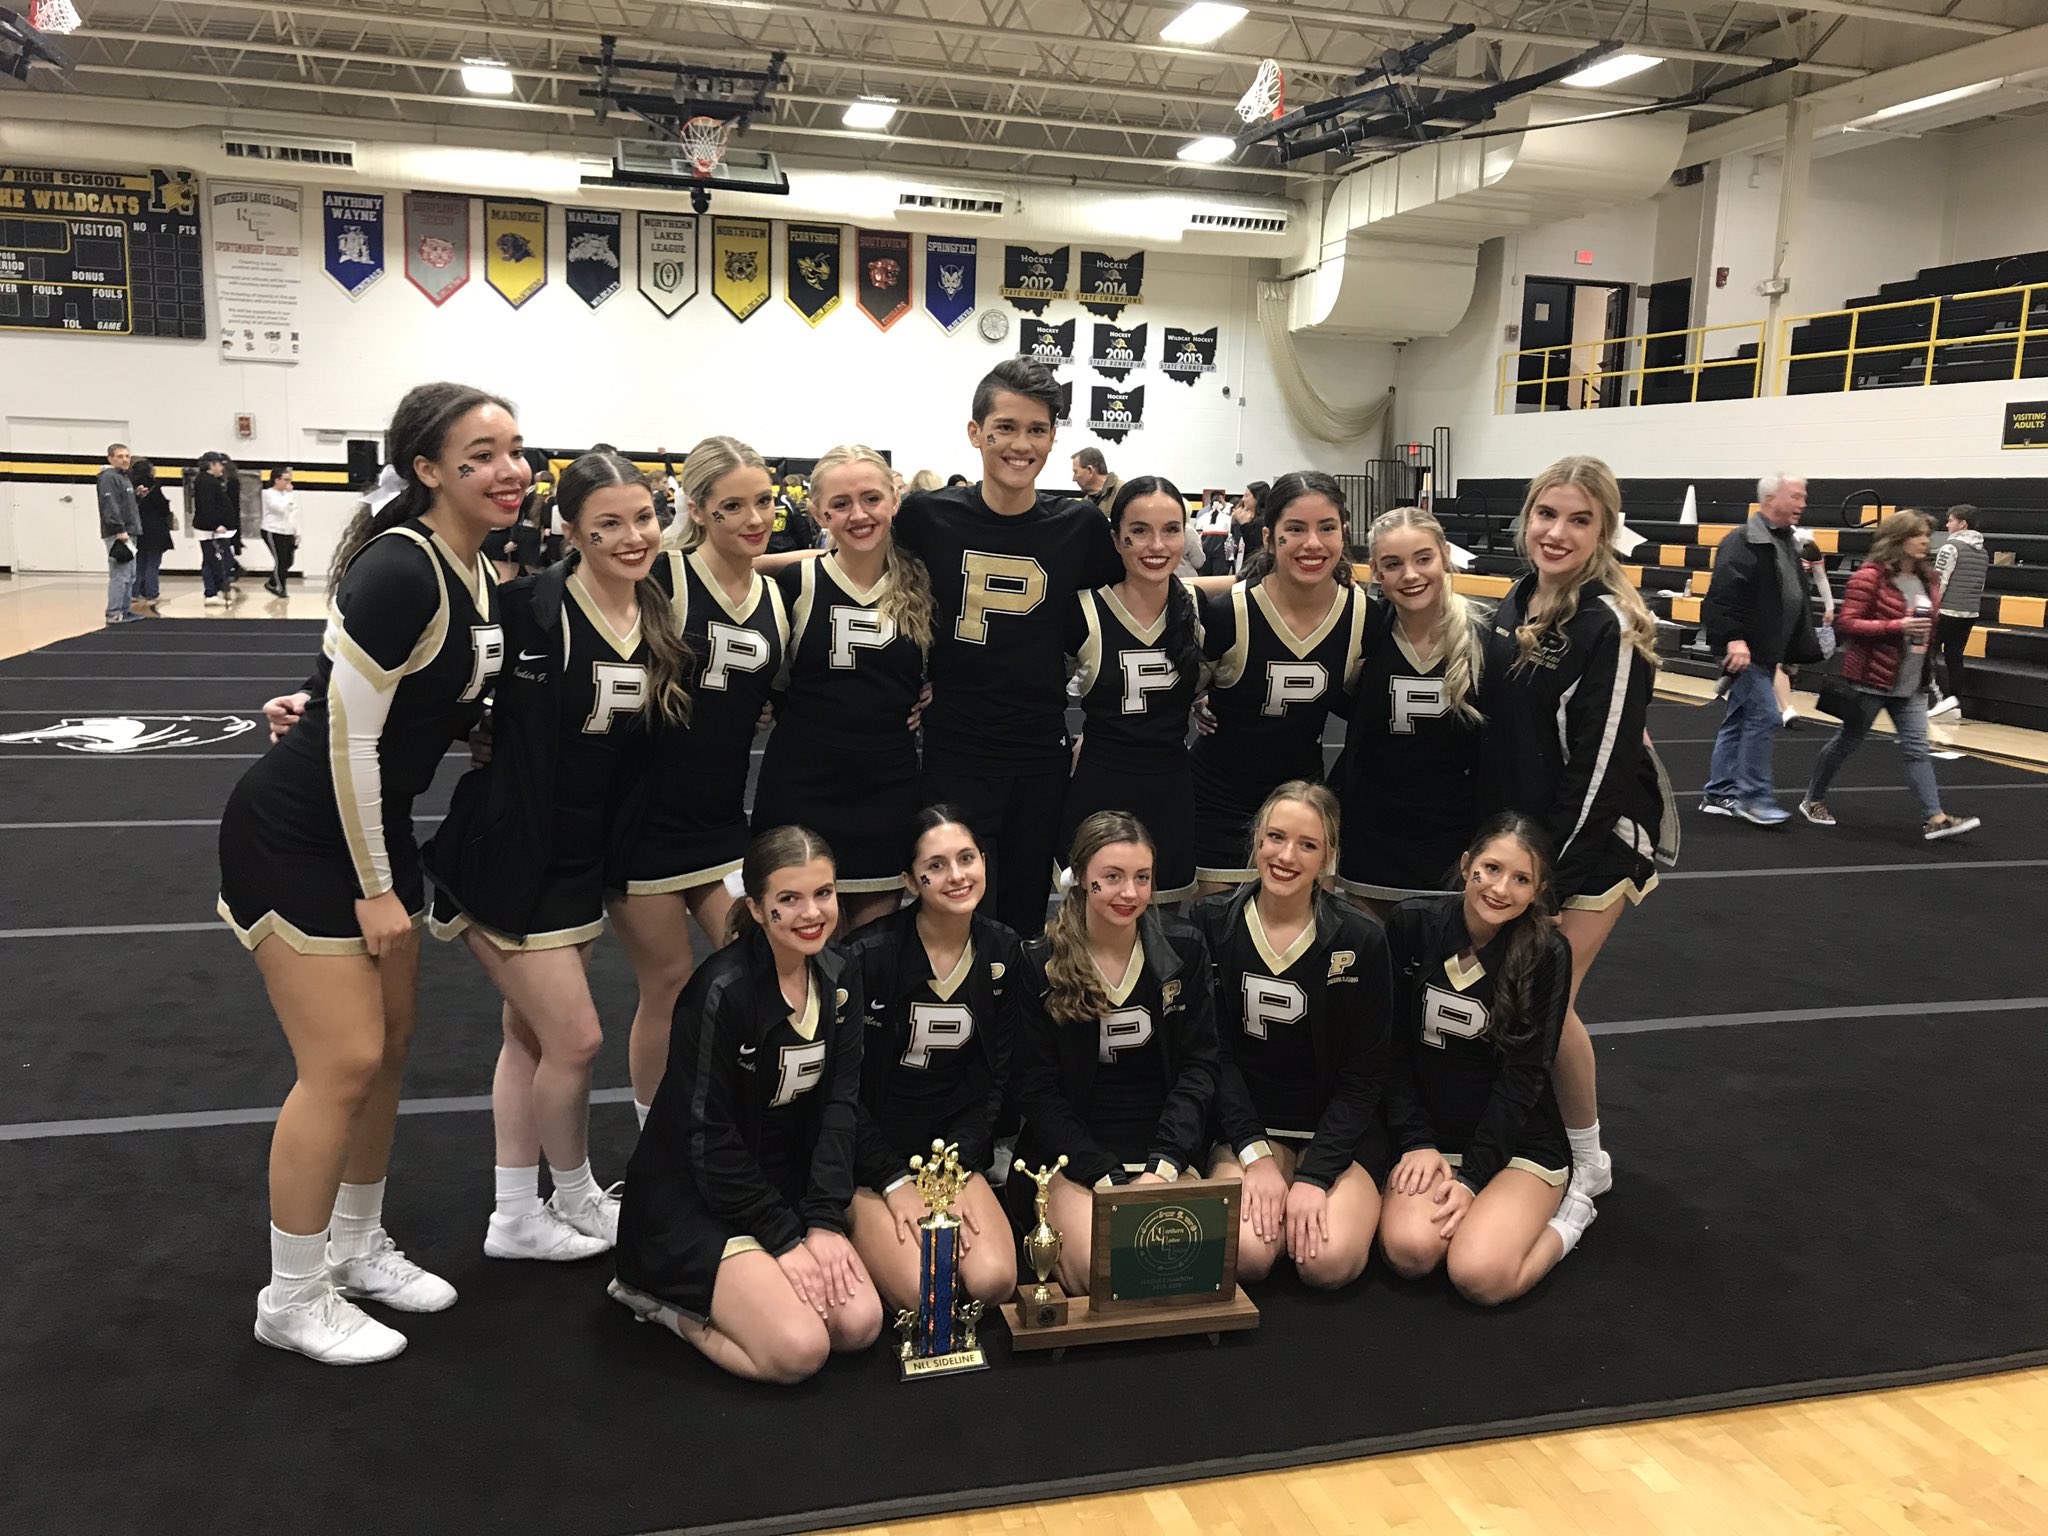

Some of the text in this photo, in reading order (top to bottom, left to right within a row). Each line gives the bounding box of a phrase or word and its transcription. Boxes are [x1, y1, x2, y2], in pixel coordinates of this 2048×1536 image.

[13, 170, 55, 183] HIGH
[61, 173, 126, 188] SCHOOL
[32, 190, 140, 216] WILDCATS
[213, 191, 298, 213] NORTHERN LAKES LEAGUE
[325, 195, 382, 209] ANTHONY
[331, 207, 378, 222] WAYNE
[491, 209, 542, 223] MAUMEE
[567, 211, 619, 226] NAPOLEON
[71, 222, 123, 238] VISITOR
[133, 222, 148, 233] NO
[160, 224, 168, 234] F
[178, 225, 197, 236] PTS
[643, 218, 694, 230] NORTHERN
[653, 231, 685, 242] LAKES
[716, 225, 767, 239] NORTHVIEW
[789, 230, 839, 245] PERRYSBURG
[651, 242, 687, 254] LEAGUE
[859, 236, 908, 249] SOUTHVIEW
[927, 240, 977, 255] SPRINGFIELD
[72, 271, 105, 281] BONUS
[1020, 275, 1054, 291] 2012
[33, 285, 63, 296] FOULS
[92, 288, 123, 299] FOULS
[590, 280, 621, 308] WILDCATS
[1000, 287, 1068, 300] STATE CHAMPIONS
[1094, 280, 1128, 296] 2014
[738, 291, 768, 318] WILDCATS
[1075, 293, 1142, 305] STATE CHAMPIONS
[63, 319, 82, 329] TOL
[97, 321, 122, 331] GAME
[1031, 343, 1063, 357] 2006
[1105, 347, 1134, 361] 2010
[1037, 355, 1074, 366] RUNNER-UP
[1089, 358, 1146, 369] STATE RUNNER-UP
[1175, 352, 1204, 365] 2013
[1159, 364, 1215, 373] STATE RUNNER-UP
[1102, 409, 1132, 423] 1990
[2012, 412, 2047, 422] VISITING
[1087, 420, 1144, 430] STATE RUNNER-UP
[2013, 420, 2045, 429] ADULTS
[954, 549, 1047, 646] P
[828, 604, 898, 670] P
[456, 624, 503, 703] P
[700, 621, 770, 692] P
[1118, 649, 1182, 715] P
[1260, 660, 1329, 718] P
[581, 661, 648, 735] P
[1388, 675, 1453, 735] P
[1328, 950, 1356, 978] P
[1162, 978, 1181, 1009] P
[1241, 971, 1309, 1041] P
[1420, 982, 1491, 1050] P
[900, 1001, 974, 1070] P
[1099, 1004, 1155, 1065] P
[768, 1040, 825, 1109] P
[913, 1354, 976, 1371] NLL SIDELINE
